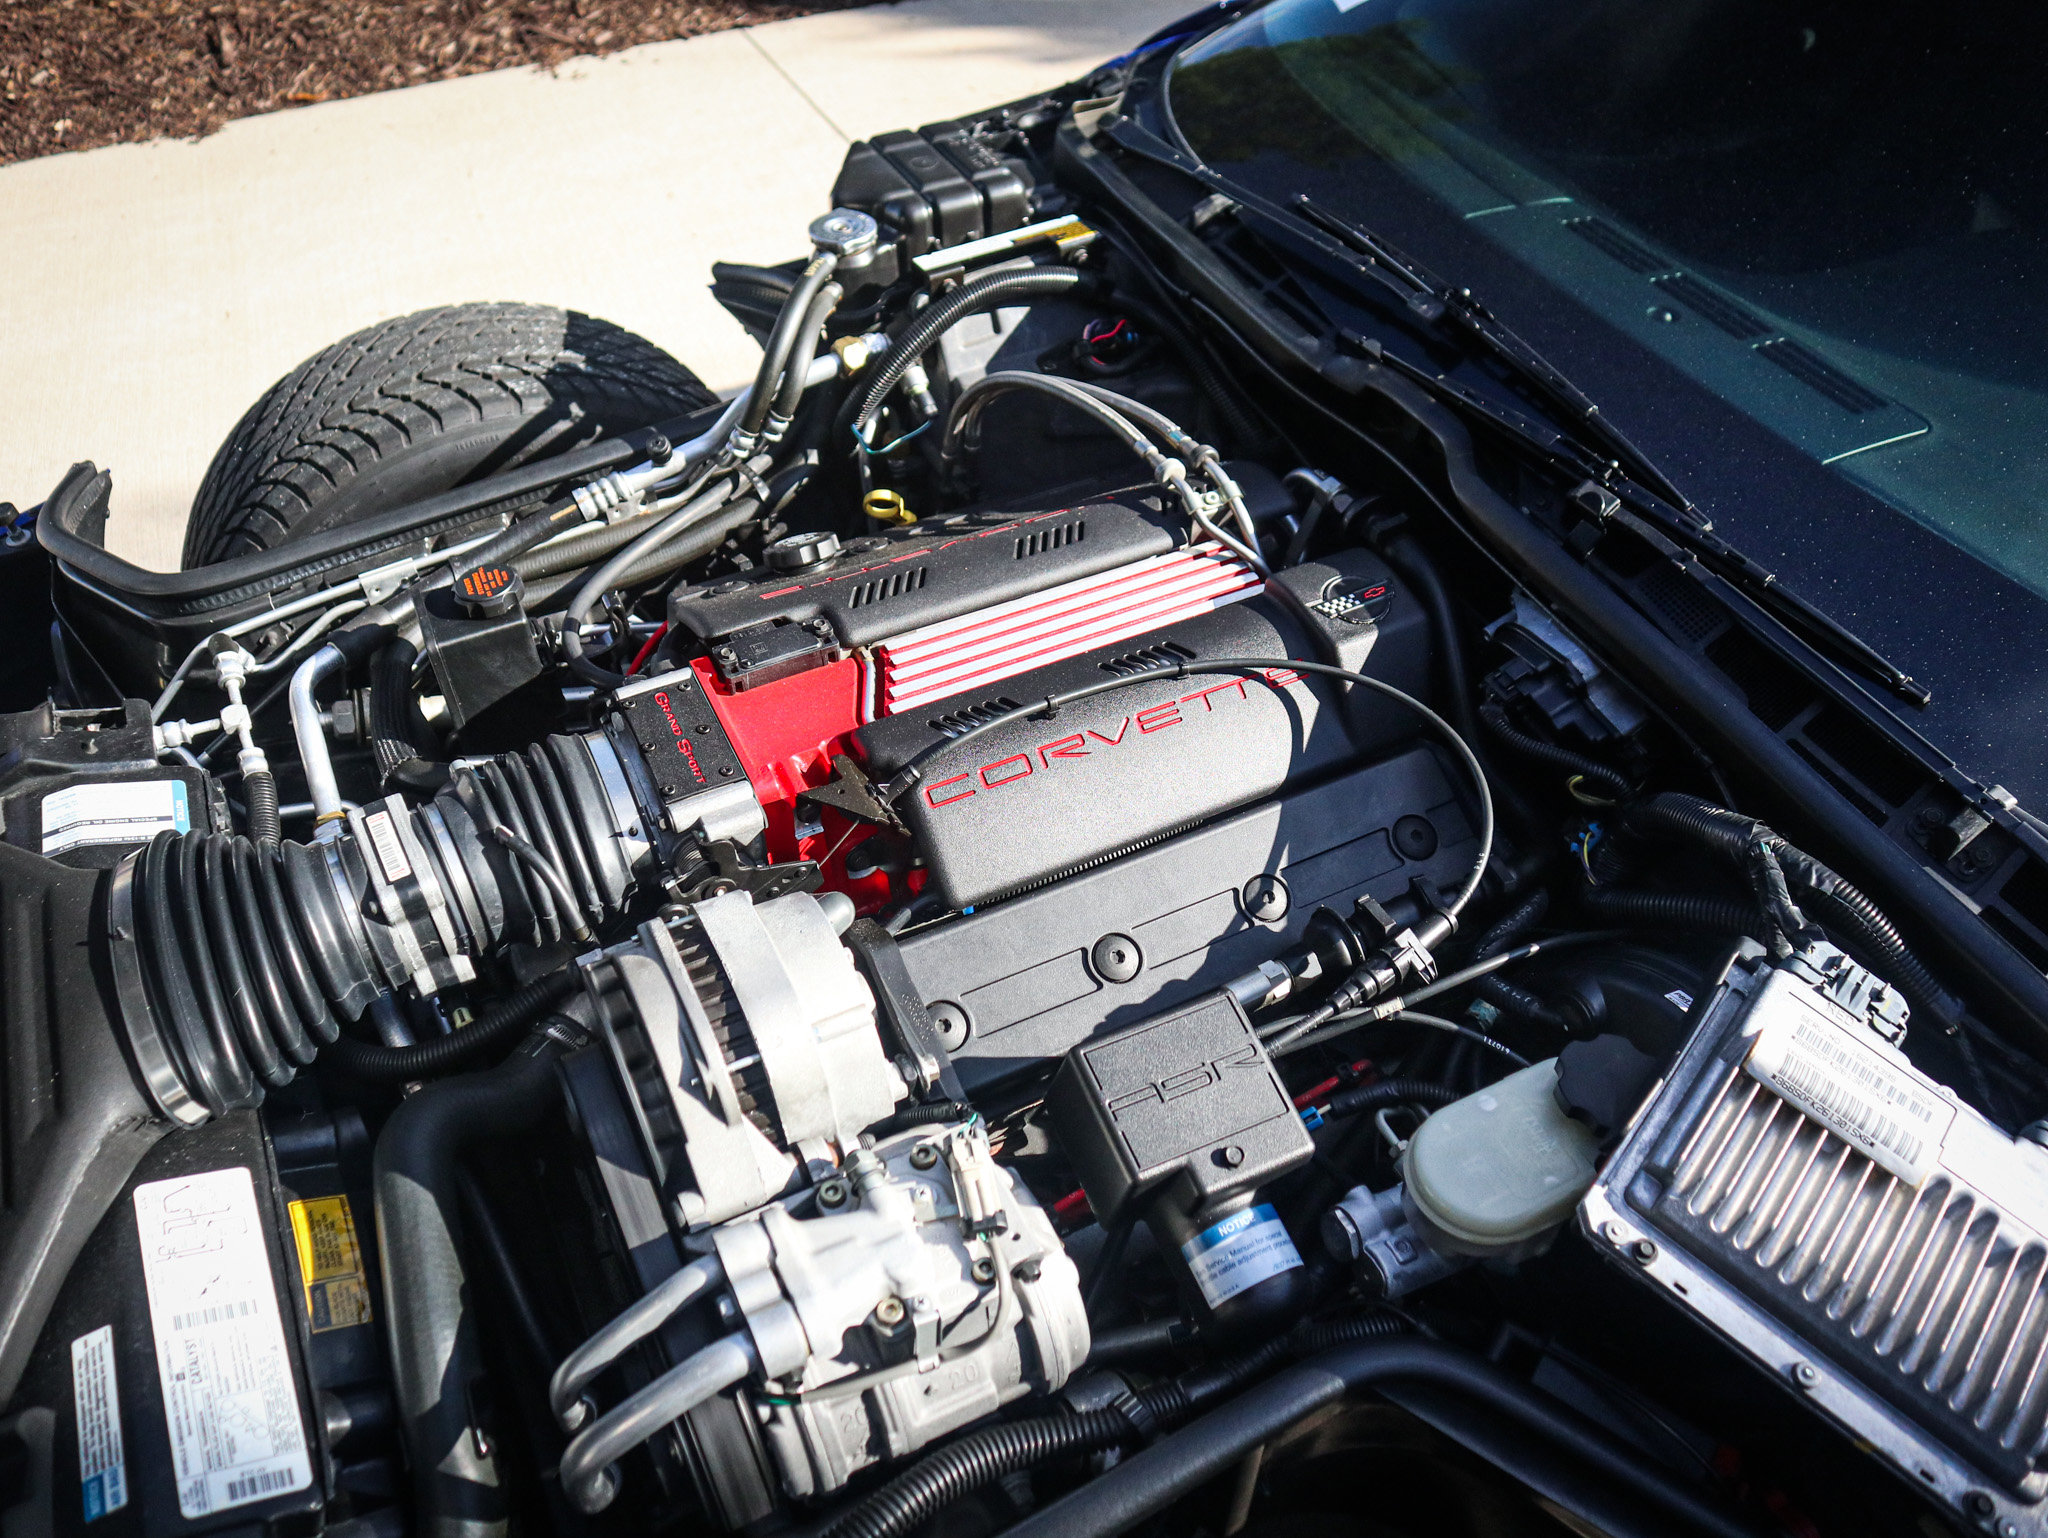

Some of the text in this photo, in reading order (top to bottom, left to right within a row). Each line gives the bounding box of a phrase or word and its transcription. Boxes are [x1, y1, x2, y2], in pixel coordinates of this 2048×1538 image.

[654, 691, 707, 784] GRAND SPORT
[923, 658, 1311, 809] CORVETTE
[184, 1336, 203, 1385] CATALYST
